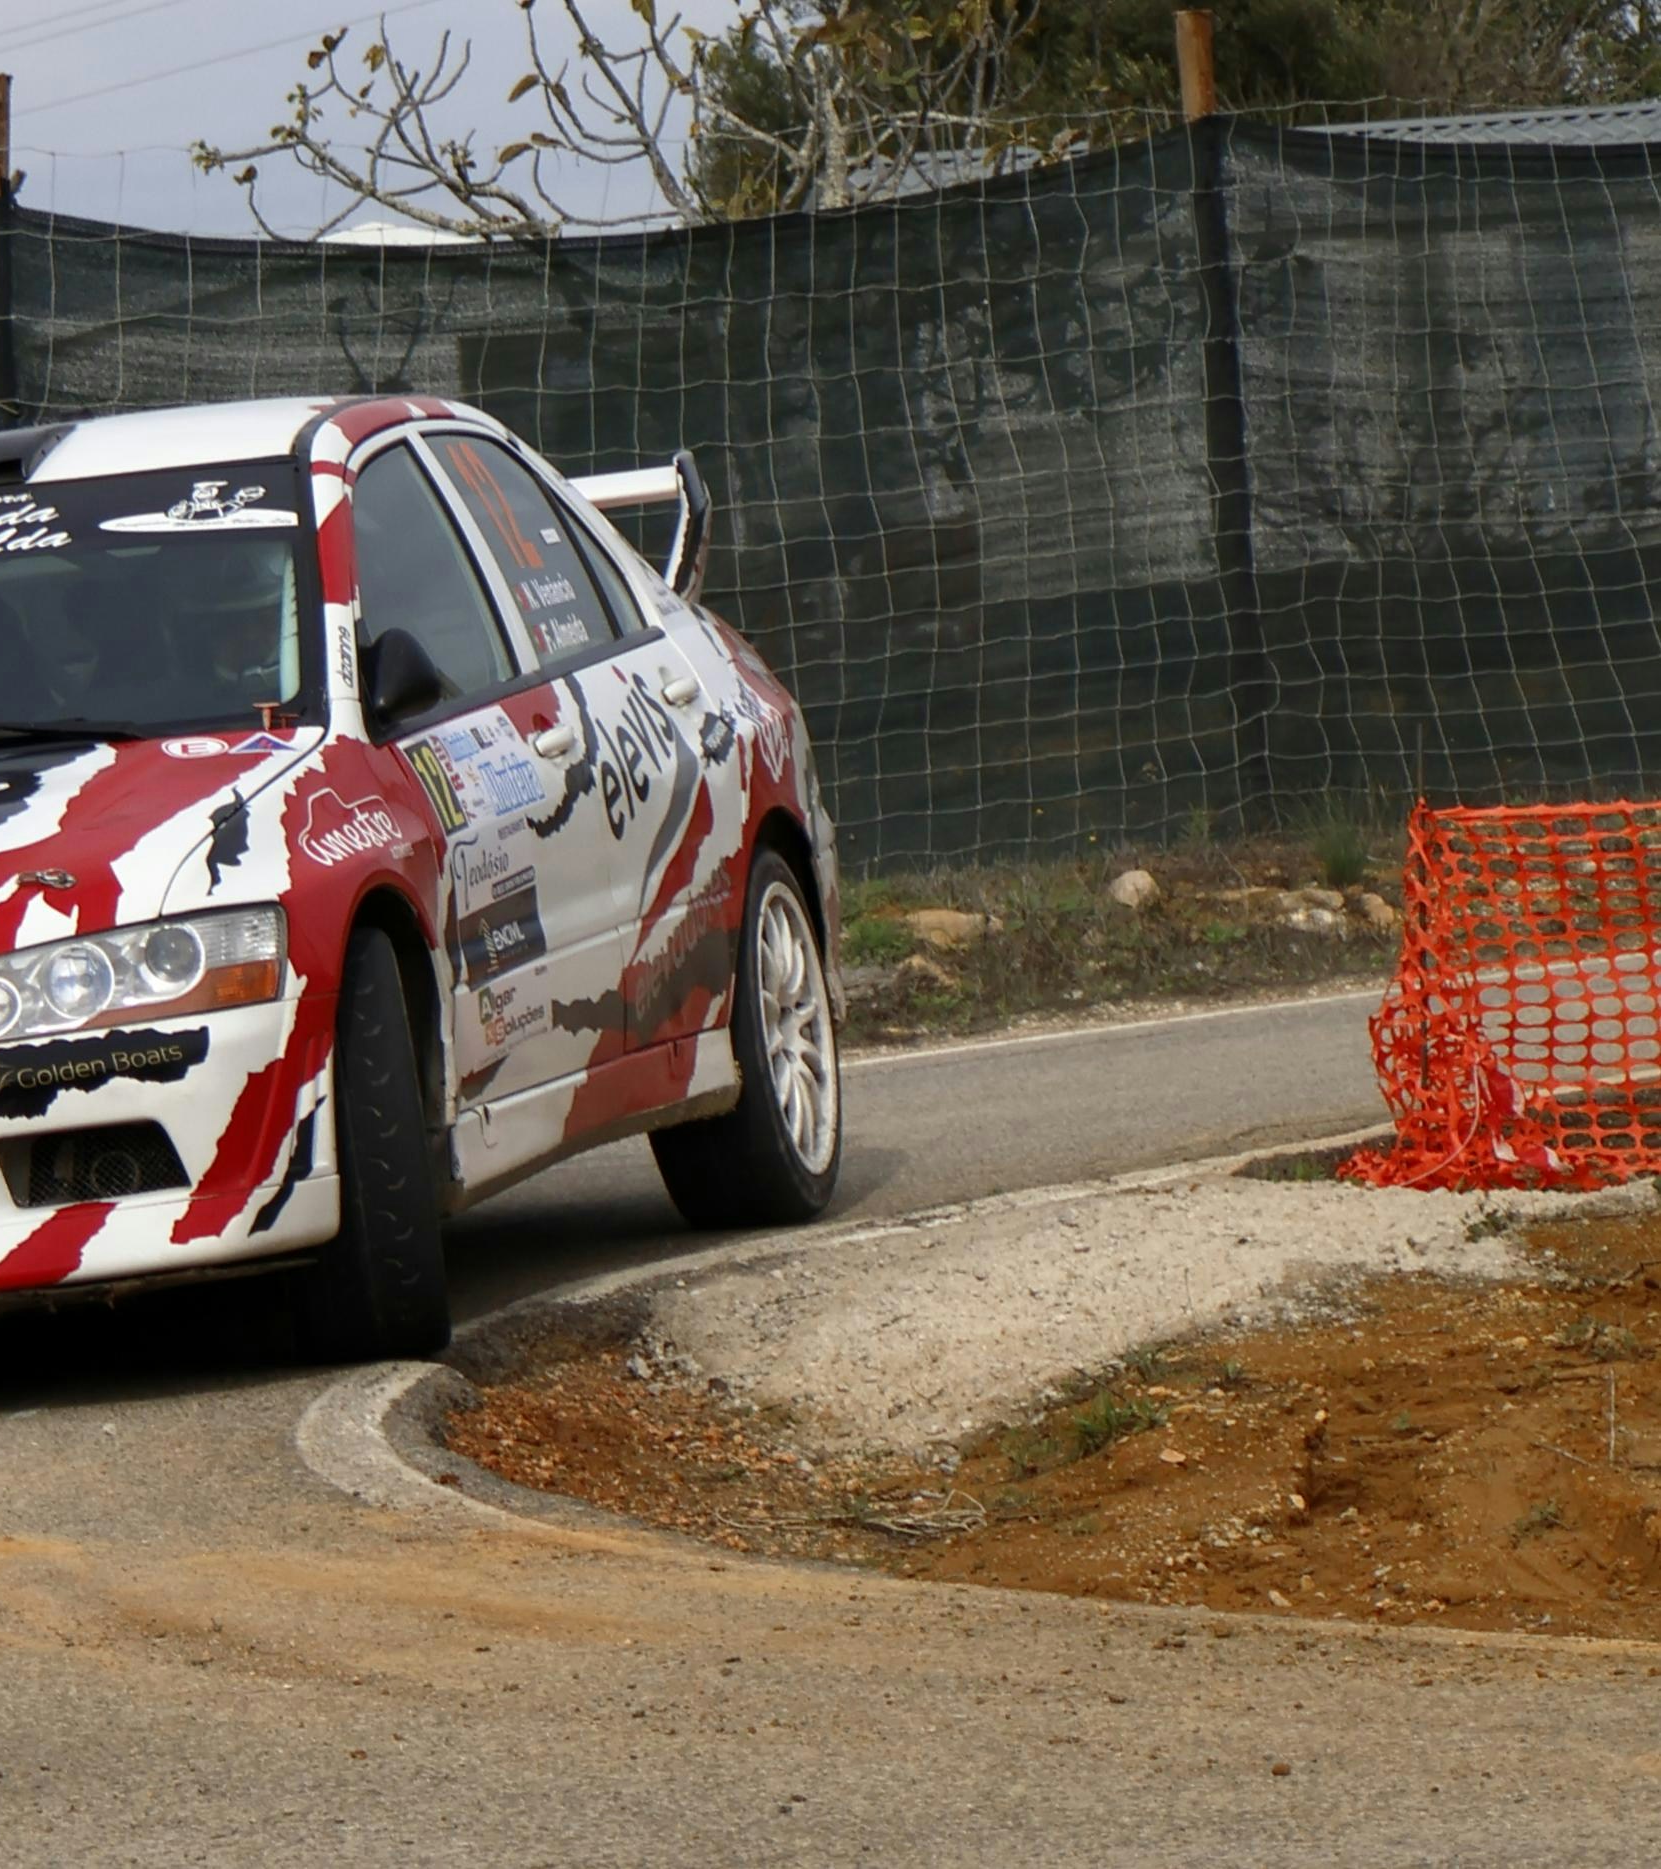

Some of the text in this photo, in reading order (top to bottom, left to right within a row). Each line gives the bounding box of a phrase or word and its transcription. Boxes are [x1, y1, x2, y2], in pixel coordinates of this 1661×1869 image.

[445, 442, 544, 569] 12
[411, 746, 465, 830] 12
[600, 665, 675, 841] elevis
[15, 1044, 184, 1090] Golden Boats
